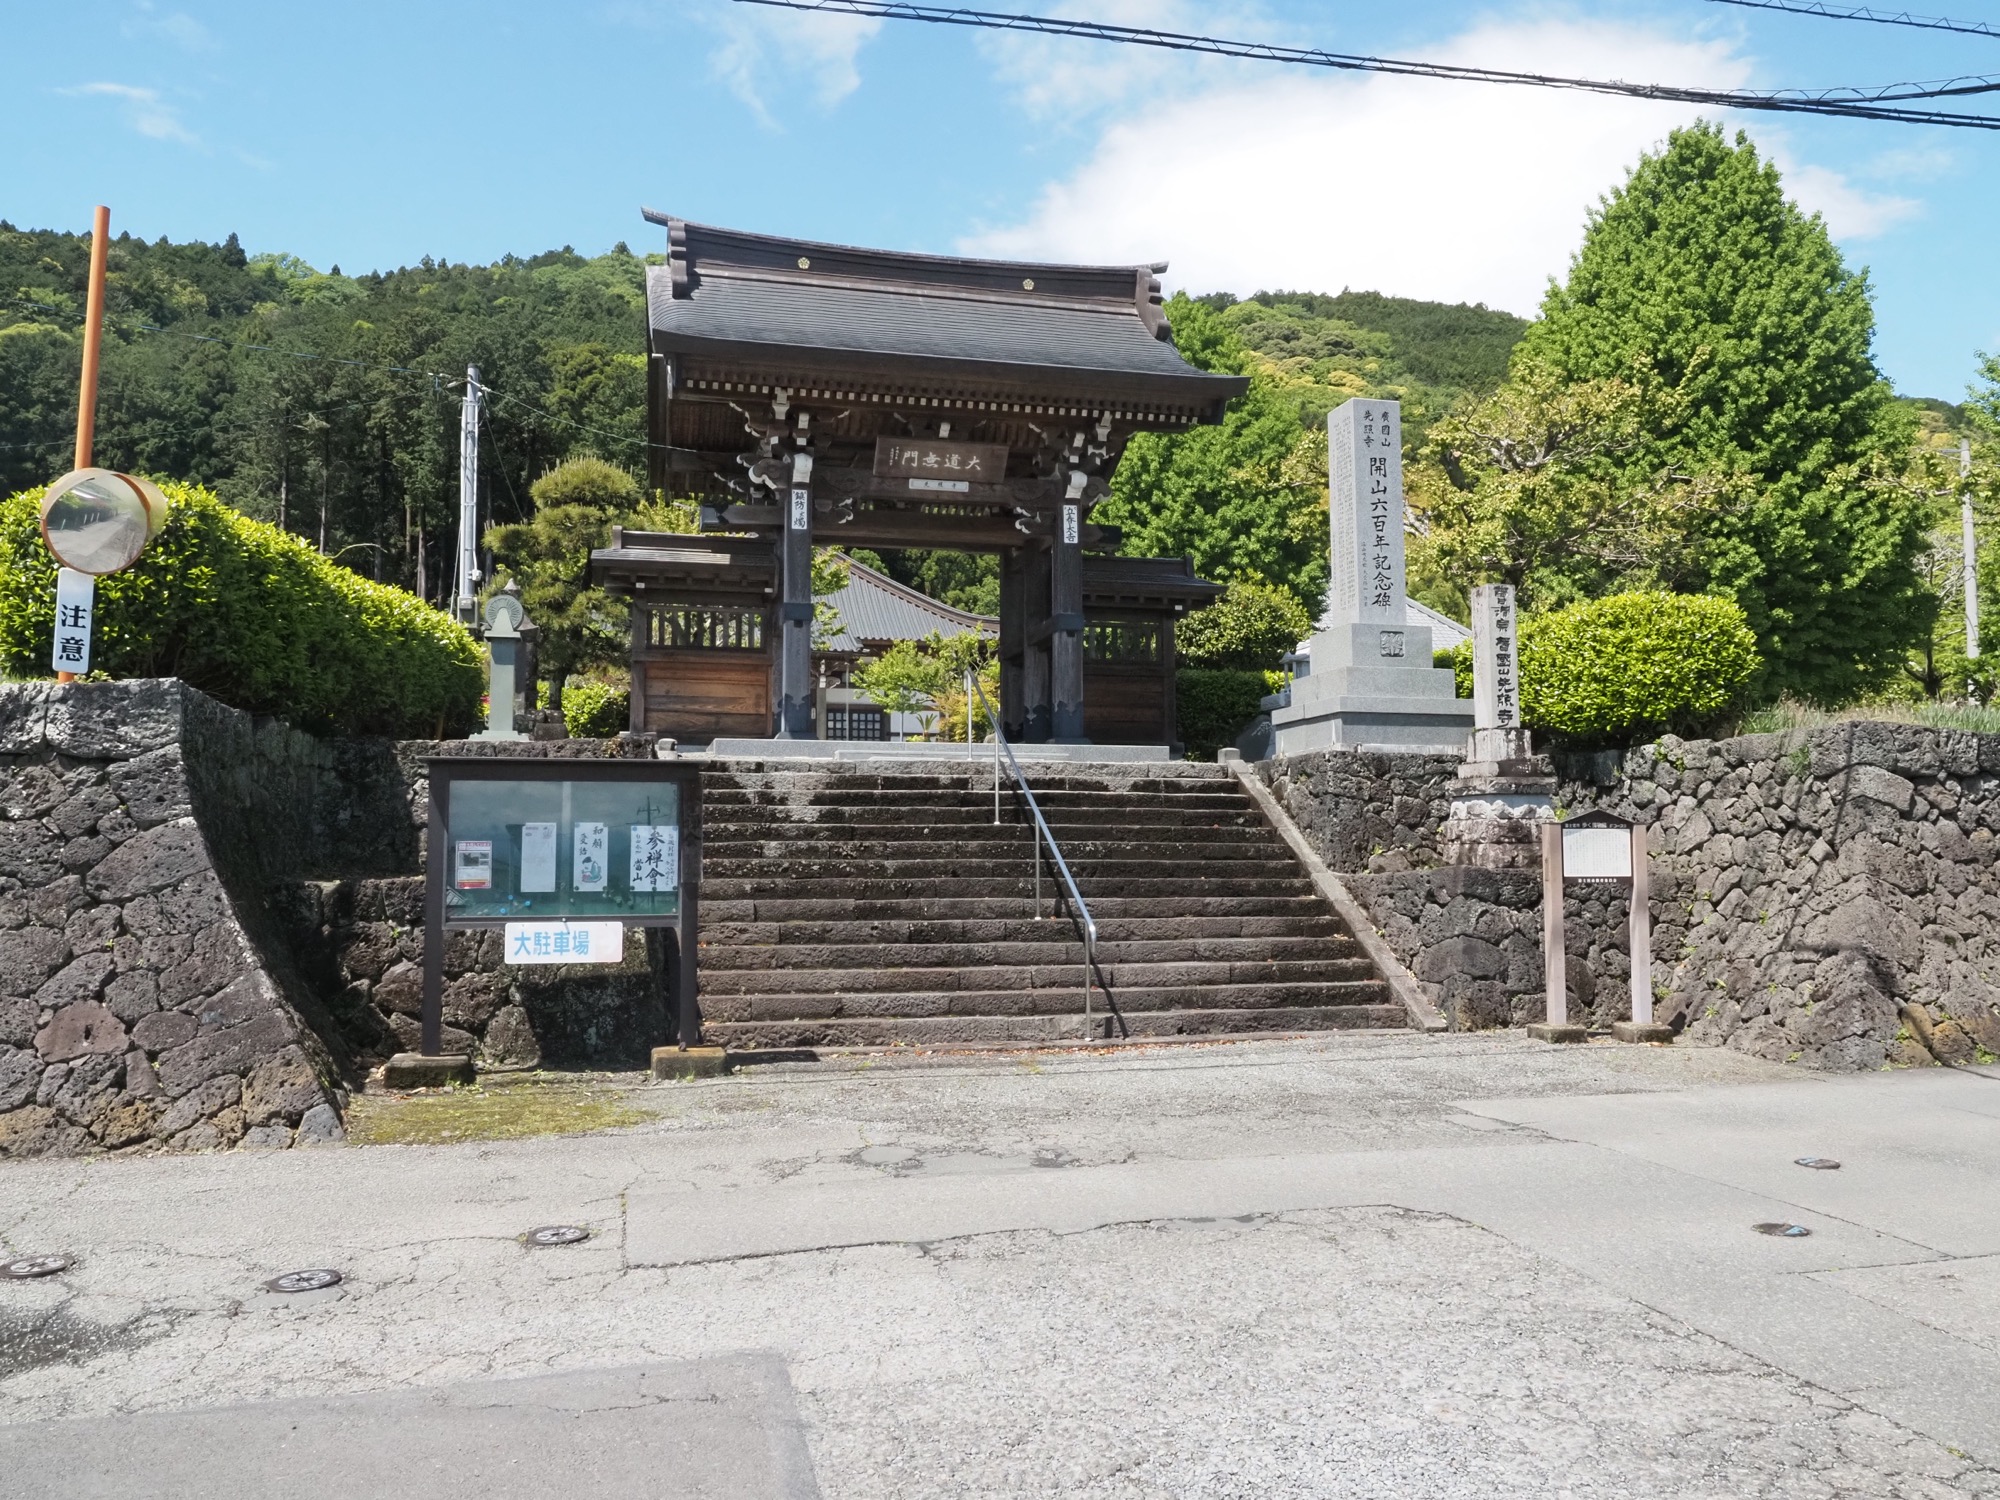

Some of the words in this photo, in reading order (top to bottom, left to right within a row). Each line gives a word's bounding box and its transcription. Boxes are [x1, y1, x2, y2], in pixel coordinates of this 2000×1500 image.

[1066, 507, 1077, 541] 立春大吉
[1369, 457, 1393, 609] 開山六百年記念碑
[59, 604, 87, 662] 注意
[514, 930, 590, 957] 大駐車場
